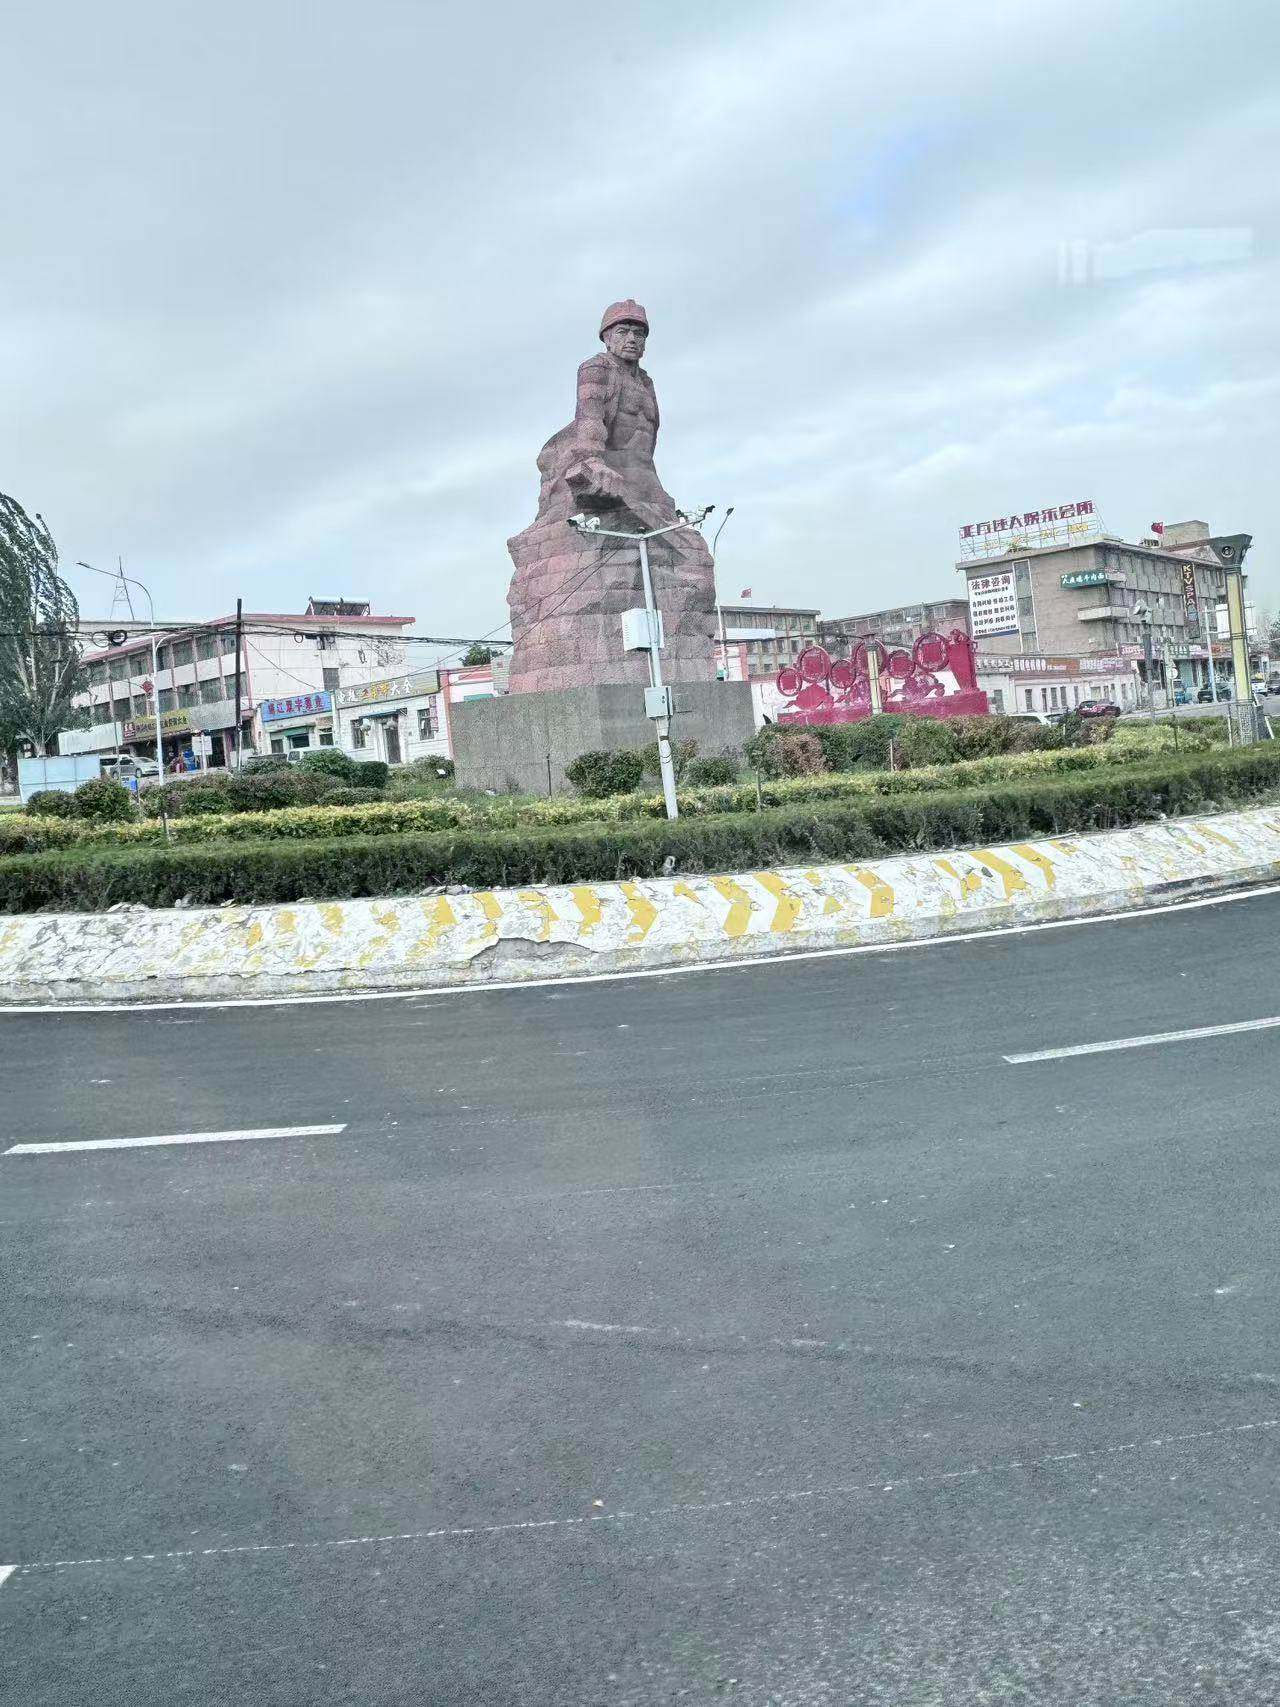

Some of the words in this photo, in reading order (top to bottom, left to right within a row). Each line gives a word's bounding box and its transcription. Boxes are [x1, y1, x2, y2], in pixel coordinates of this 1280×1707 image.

[971, 575, 1011, 591] 法律咨询
[1182, 565, 1194, 585] KTV
